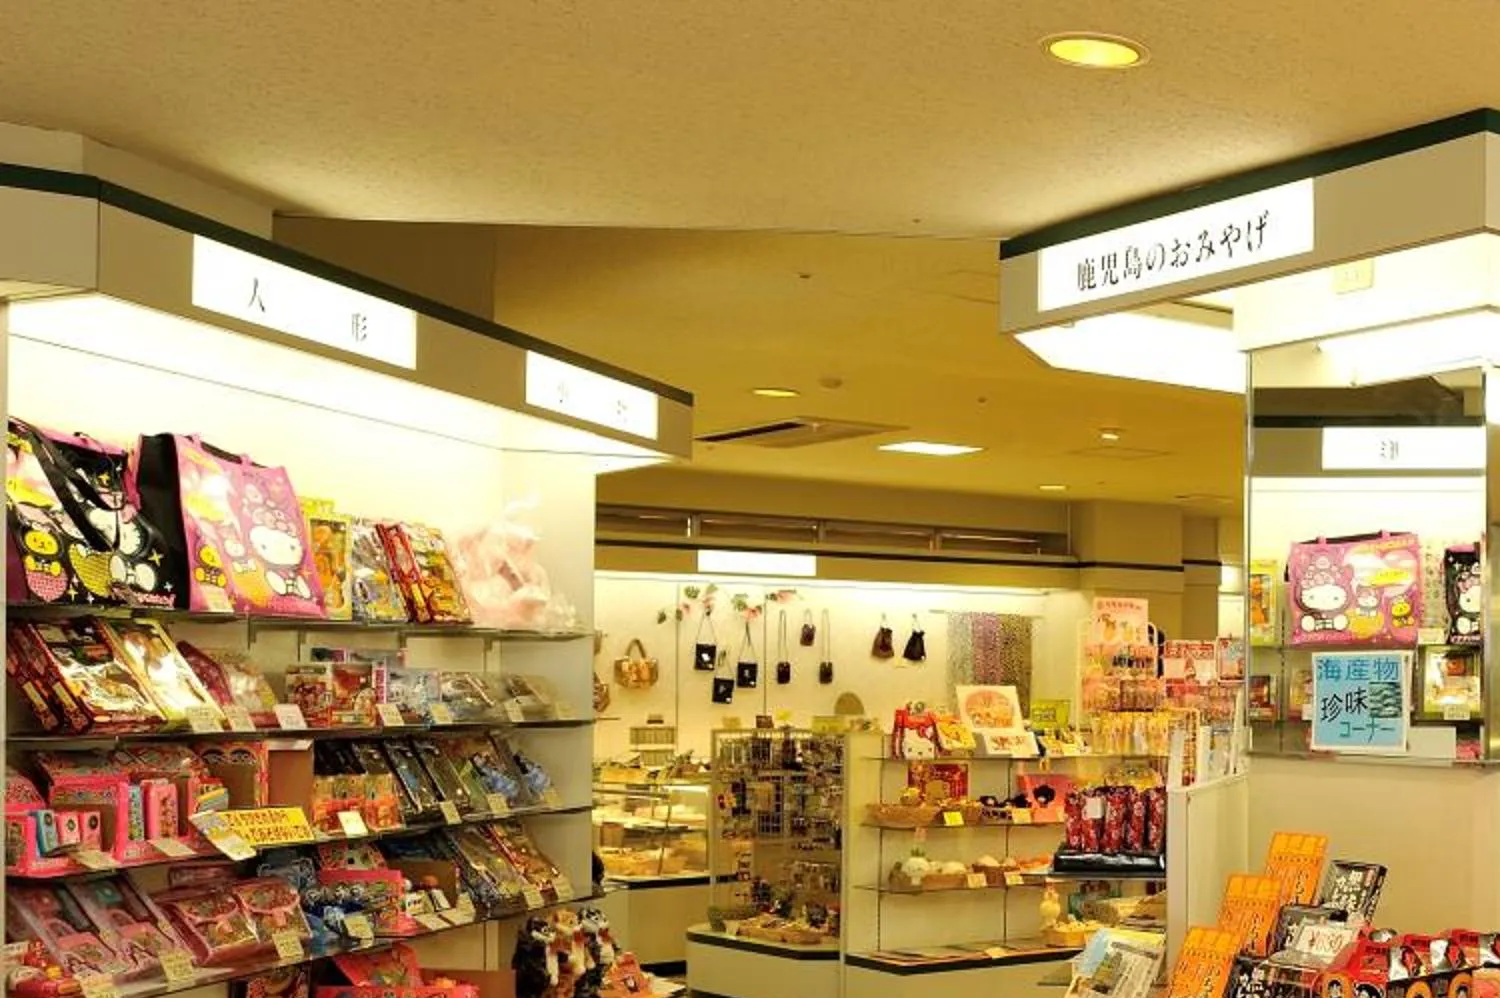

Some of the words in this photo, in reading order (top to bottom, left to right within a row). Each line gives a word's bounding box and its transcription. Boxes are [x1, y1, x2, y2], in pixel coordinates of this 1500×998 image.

[1076, 209, 1270, 292] 鹿児島のおみやげ
[1317, 659, 1399, 681] 海産物
[1340, 716, 1396, 743] コーナー
